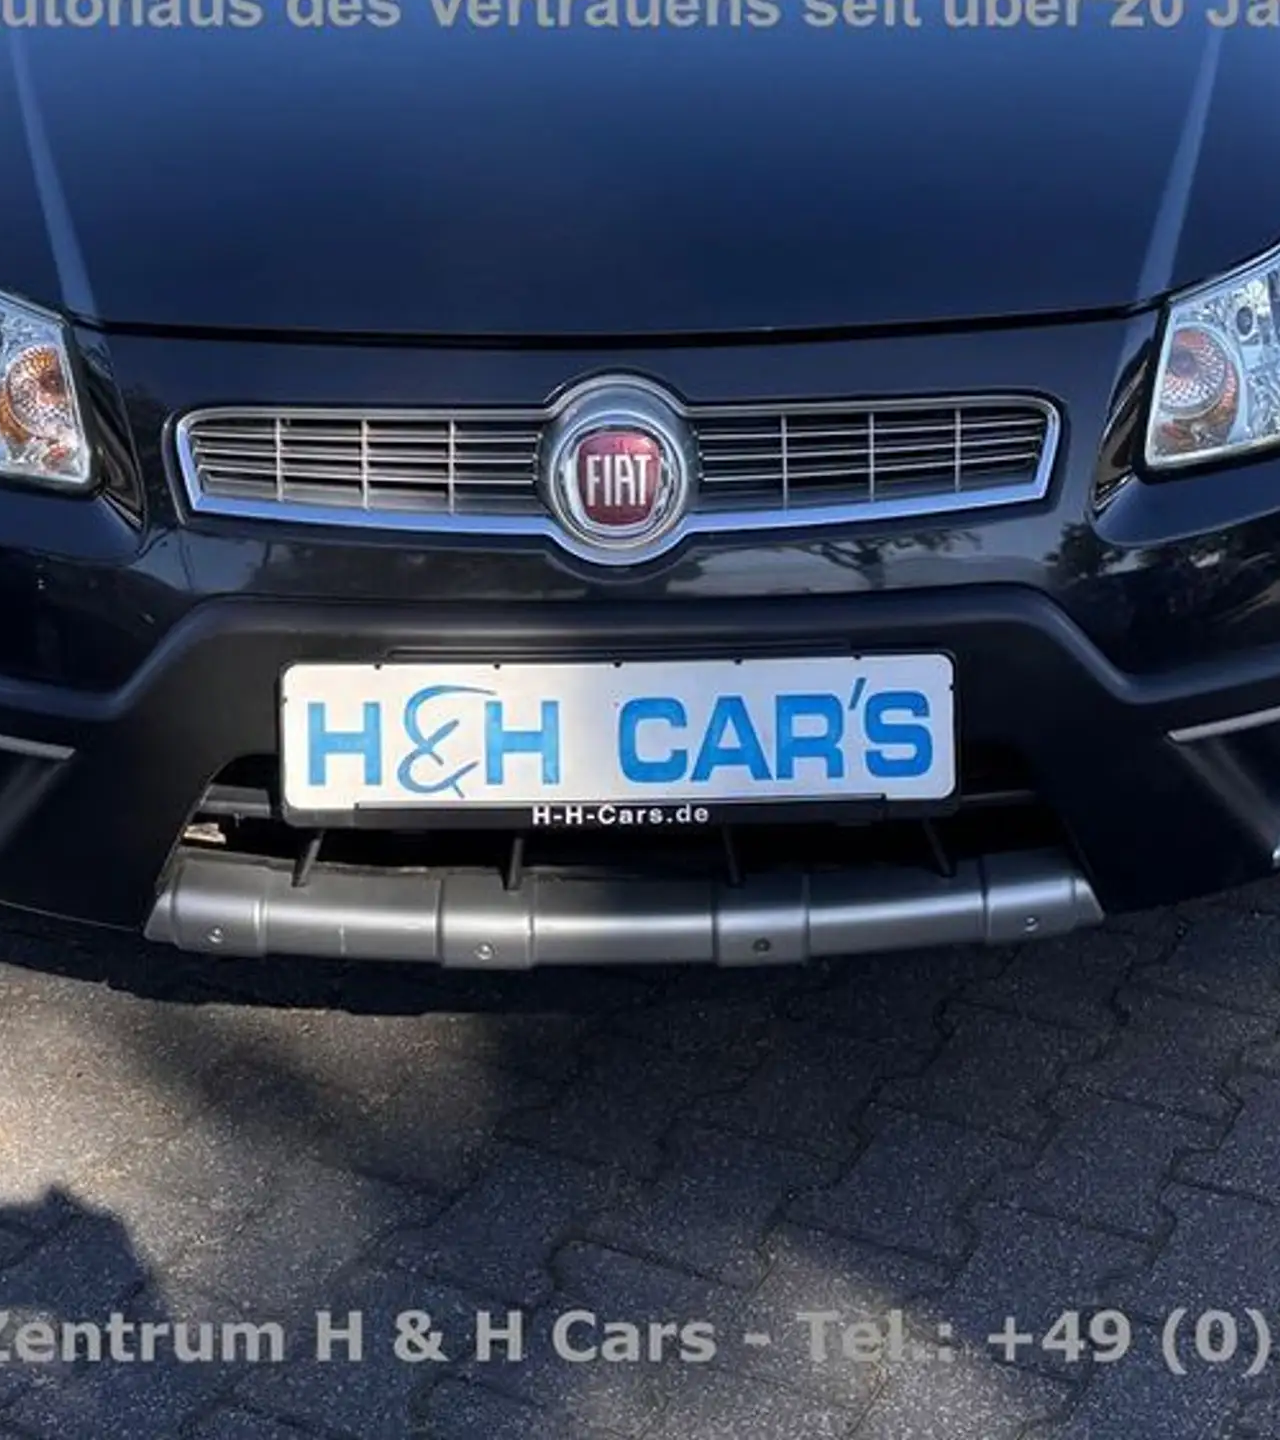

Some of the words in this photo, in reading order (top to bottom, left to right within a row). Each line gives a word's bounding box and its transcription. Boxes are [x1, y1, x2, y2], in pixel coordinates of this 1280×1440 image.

[586, 454, 652, 507] FIAT
[307, 685, 559, 798] H&H
[617, 677, 933, 784] CAR'S
[532, 804, 710, 826] H-H-Cars.de
